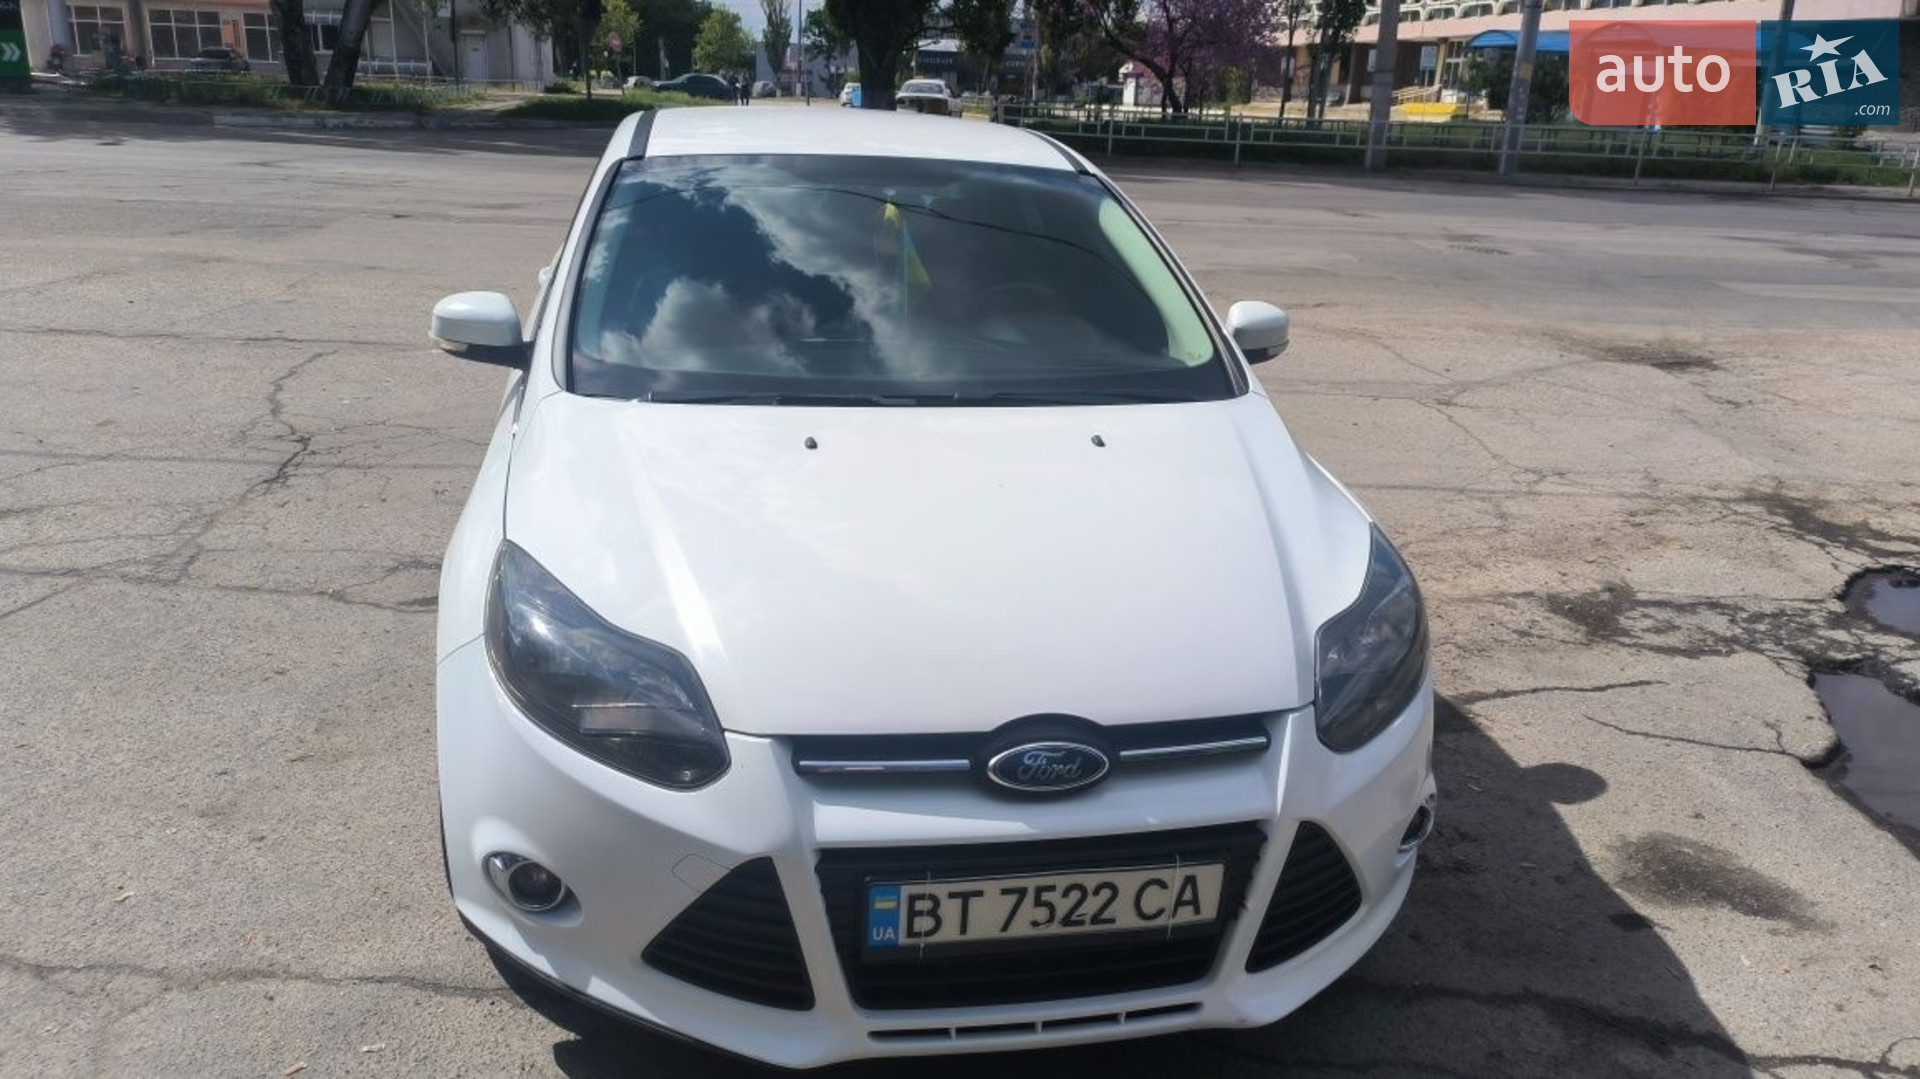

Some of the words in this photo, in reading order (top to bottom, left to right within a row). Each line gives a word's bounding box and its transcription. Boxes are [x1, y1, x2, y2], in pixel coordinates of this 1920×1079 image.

[1017, 750, 1083, 779] Ford
[905, 890, 984, 939] BT
[999, 881, 1120, 933] 7522
[1133, 874, 1202, 921] CA
[873, 927, 896, 942] UA
